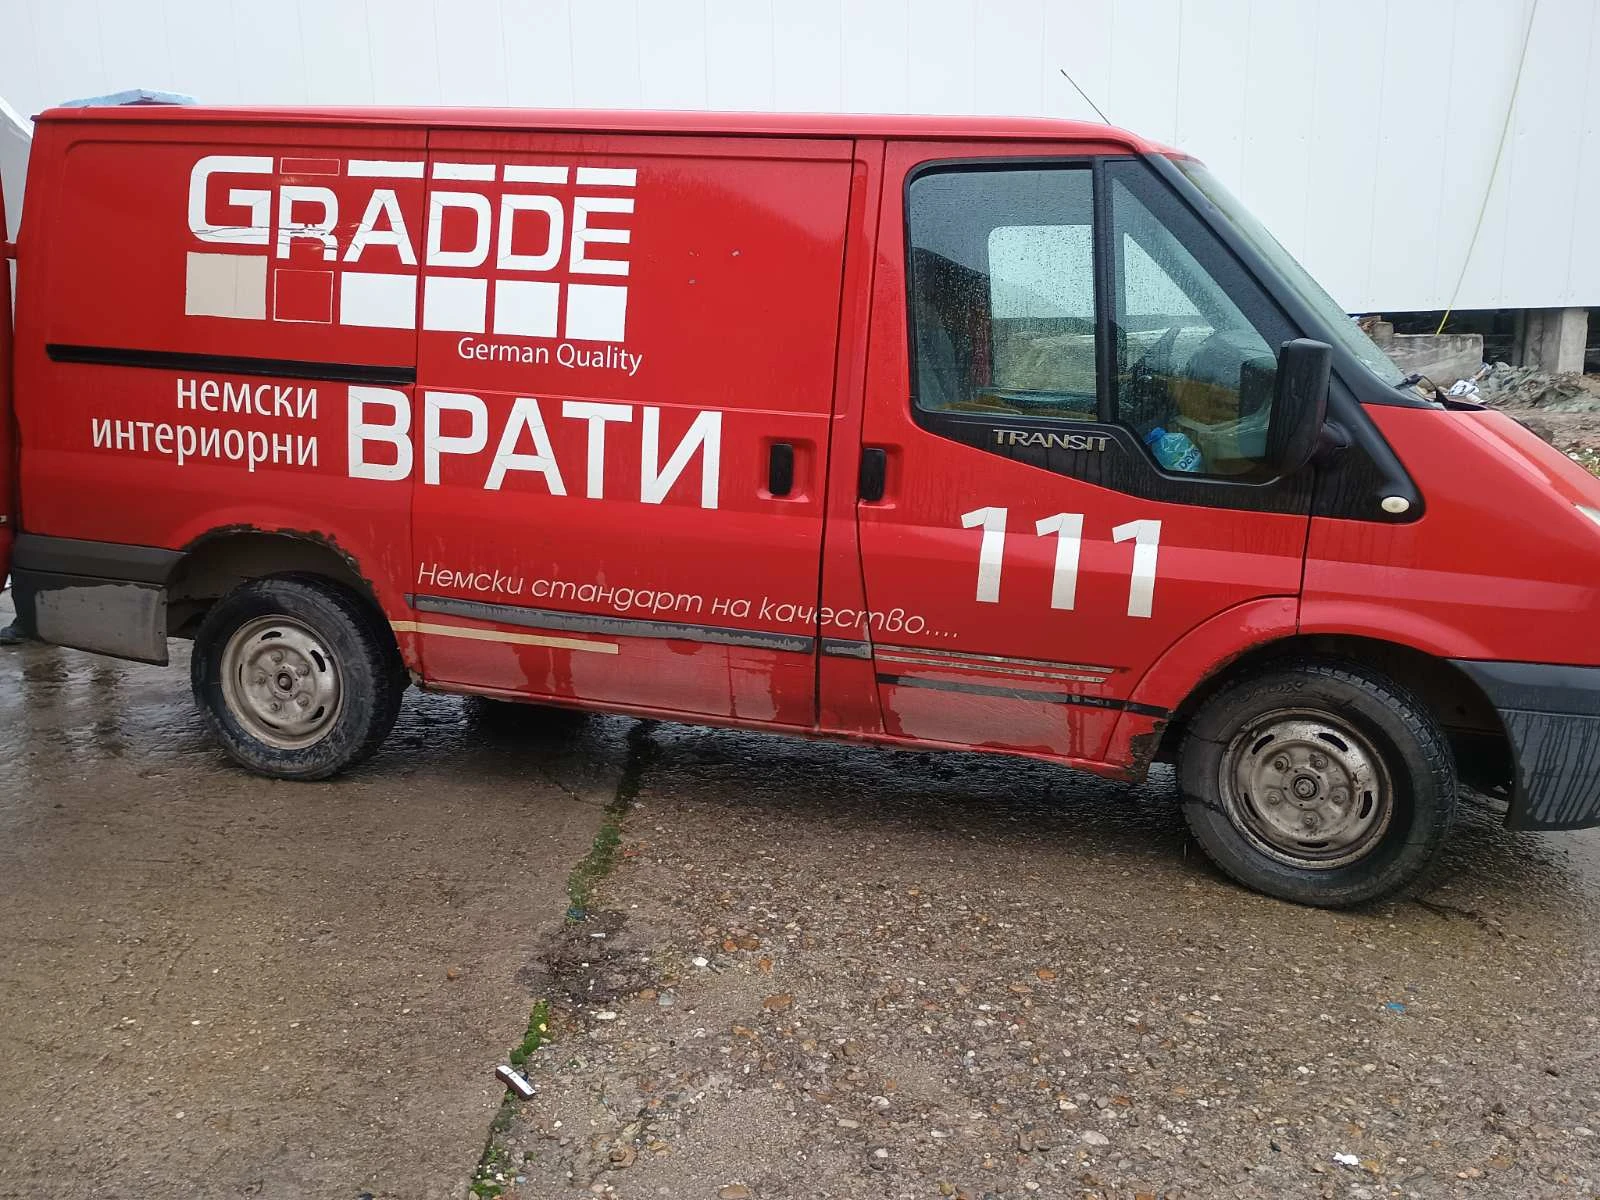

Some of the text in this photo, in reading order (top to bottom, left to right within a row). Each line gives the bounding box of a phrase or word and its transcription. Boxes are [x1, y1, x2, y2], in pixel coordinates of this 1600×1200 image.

[187, 155, 635, 277] GRADDE
[457, 336, 643, 377] German Quality
[177, 378, 317, 420] немски
[92, 418, 318, 473] интериорни
[347, 385, 723, 510] ВРАТИ
[993, 429, 1110, 452] TRANSIT
[417, 562, 524, 595] Немски
[531, 579, 703, 614] стандарт
[711, 597, 752, 618] на
[960, 506, 1162, 619] 111
